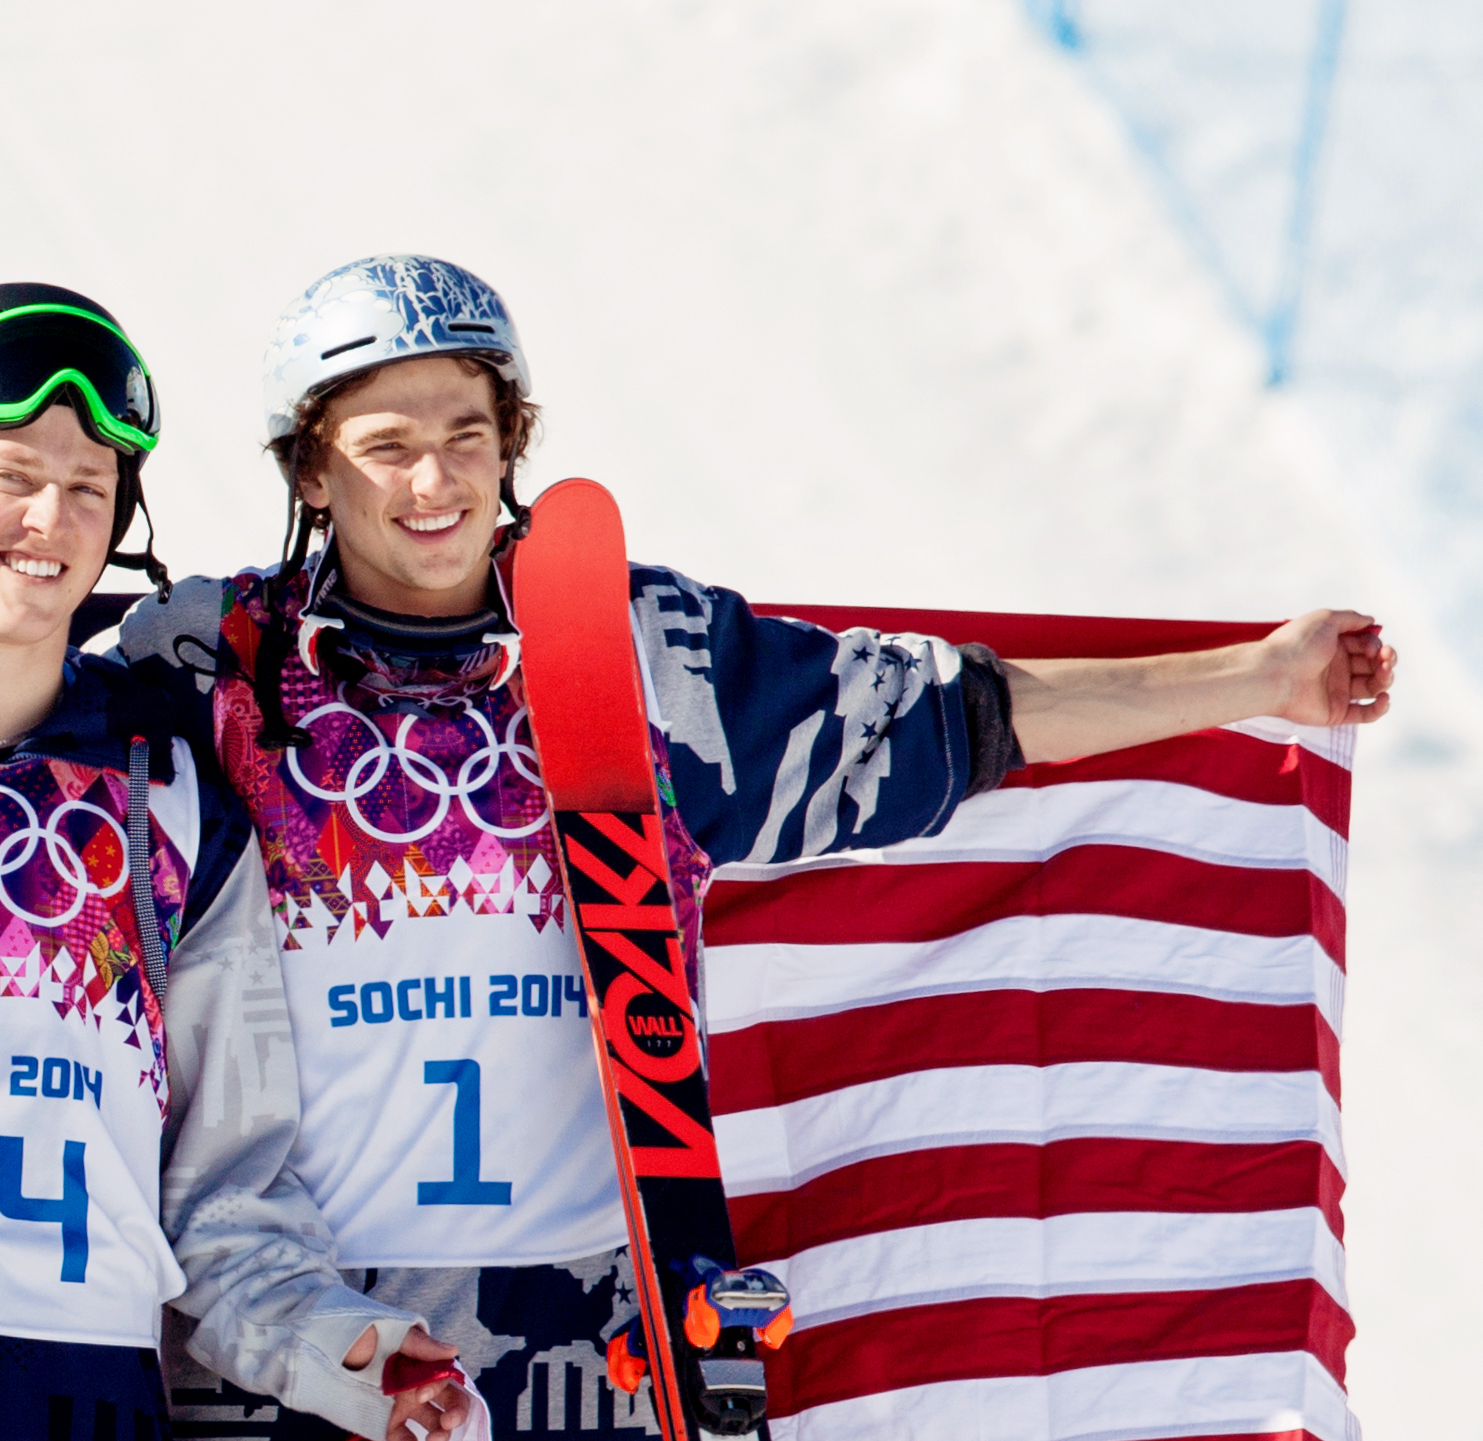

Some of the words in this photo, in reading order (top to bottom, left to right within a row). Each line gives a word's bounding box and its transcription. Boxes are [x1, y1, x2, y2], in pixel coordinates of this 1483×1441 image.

[327, 975, 472, 1028] SOCHI
[488, 974, 588, 1018] 2014
[628, 1015, 683, 1037] WALL
[9, 1055, 103, 1110] 2014
[416, 1058, 513, 1206] 1
